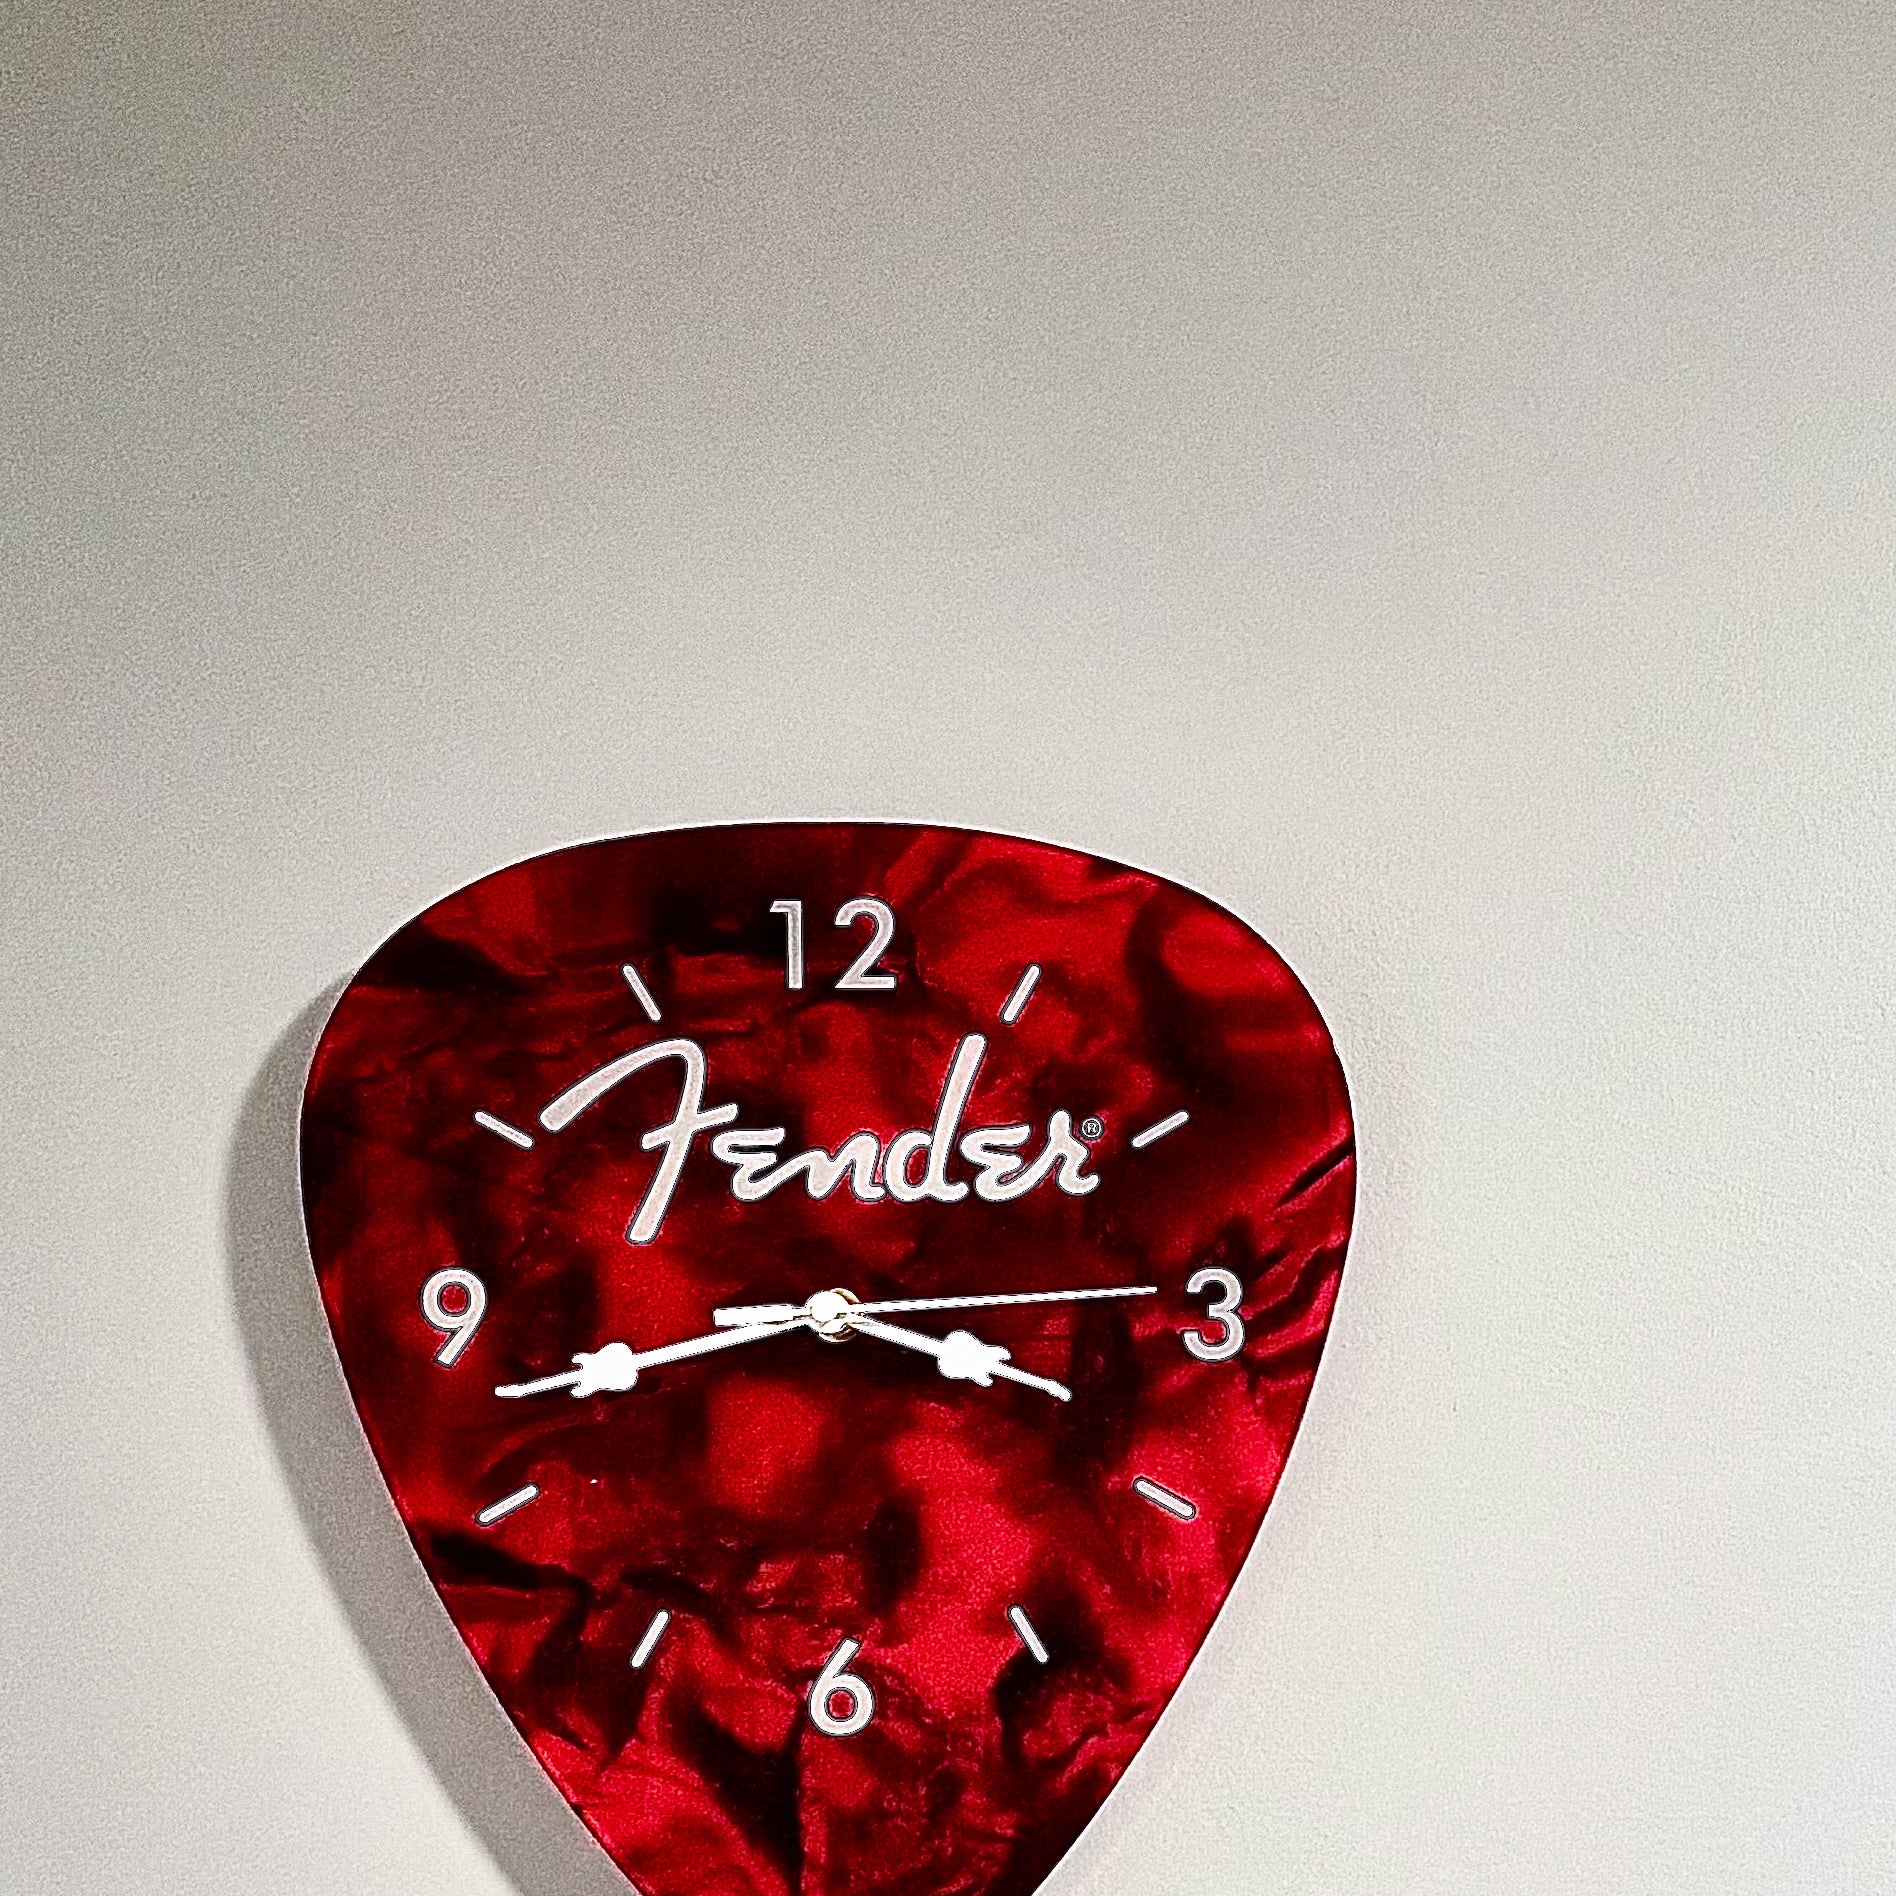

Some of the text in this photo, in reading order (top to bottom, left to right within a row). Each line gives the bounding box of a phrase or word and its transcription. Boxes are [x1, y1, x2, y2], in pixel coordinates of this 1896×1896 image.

[769, 897, 897, 990] 12
[420, 1266, 487, 1368] 9
[1181, 1266, 1247, 1363] 3
[808, 1637, 876, 1737] 6
